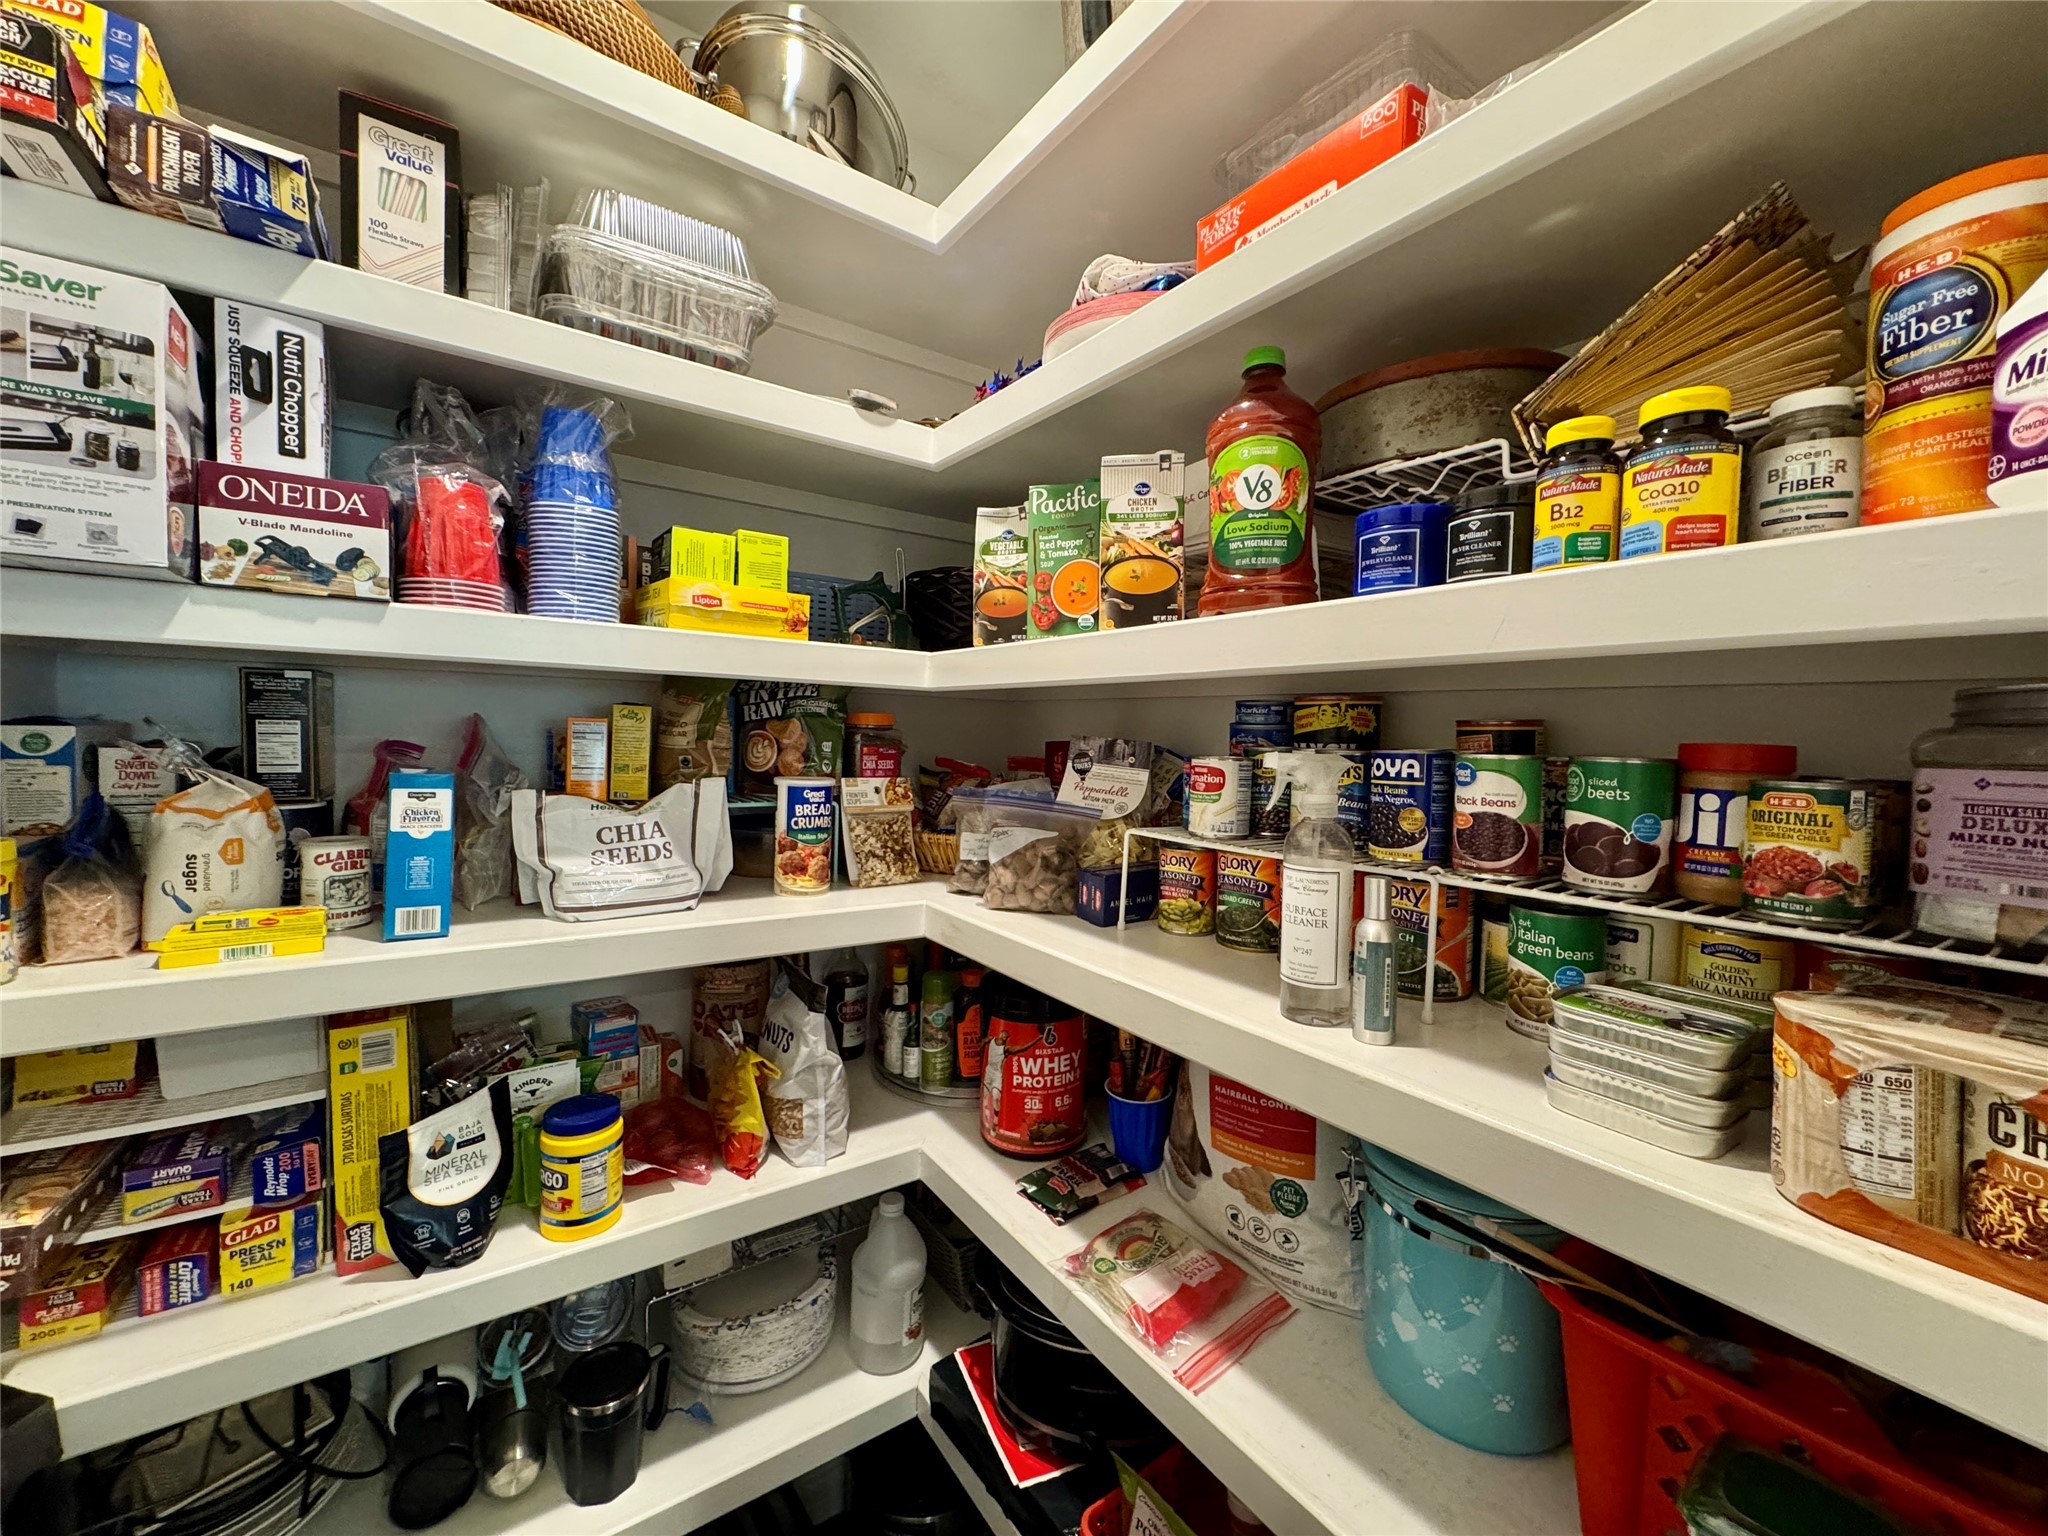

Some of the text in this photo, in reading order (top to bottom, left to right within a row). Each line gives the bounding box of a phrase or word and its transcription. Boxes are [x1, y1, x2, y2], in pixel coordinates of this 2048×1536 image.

[368, 125, 434, 165] Great
[162, 127, 180, 194] PARCHMENT
[384, 148, 434, 175] Value
[183, 150, 201, 186] PAPER
[291, 193, 307, 215] 75
[368, 217, 388, 230] 100
[1200, 201, 1246, 242] PLASTIC
[368, 226, 398, 241] Flexible
[399, 235, 425, 249] Straws
[1203, 218, 1239, 250] FORKS
[1882, 283, 1979, 328] Sugar Free
[1880, 306, 1974, 356] Fiber
[1909, 337, 1963, 360] SUPPLEMENT
[227, 304, 243, 463] JUST SQUEEZE AND CHOP!
[1888, 366, 1965, 394] MADE WITH 100%
[1920, 378, 1961, 394] ORANGE
[20, 382, 104, 404] WAYS TO SAVE
[1666, 445, 1717, 454] RECOMMENDED
[1785, 449, 1832, 463] ocean
[1911, 443, 1948, 458] HEART
[1243, 470, 1273, 503] V8
[1638, 480, 1700, 502] CoQ10
[1778, 476, 1835, 495] FIBER
[218, 474, 369, 517] ONEIDA
[1029, 485, 1100, 515] Pacific
[1127, 497, 1158, 507] CHICKEN
[1659, 497, 1692, 506] STRENGTH
[1900, 496, 1915, 507] 72
[6, 500, 112, 518] PRESERVATION SYSTEM
[1551, 503, 1583, 521] B12
[1667, 505, 1680, 513] mg
[1779, 503, 1828, 514] Daily Prebiotics
[238, 517, 354, 539] V-Blade Mandoline
[1038, 523, 1067, 533] Organic
[1227, 522, 1289, 535] Low Sodium
[1566, 521, 1580, 529] mcg
[1695, 522, 1719, 530] support
[1459, 530, 1489, 541] Brilliant
[990, 541, 1024, 551] VEGETABLE
[1039, 538, 1084, 551] Red Pepper
[1229, 540, 1288, 550] 100% VEGETABLE JUICE
[1371, 544, 1398, 554] Brilliant
[1452, 541, 1502, 554] SILVER CLEANER
[1039, 548, 1079, 559] & Tomato
[1040, 560, 1054, 568] SOUP
[1361, 556, 1383, 567] JEWELRY
[694, 595, 720, 607] Lipton
[743, 700, 785, 721] RAW
[115, 759, 158, 770] Swans
[862, 760, 894, 769] CHIA SEEDS
[1074, 761, 1092, 770] TOURS
[112, 782, 161, 790] Cake Flour
[1074, 781, 1130, 798] Pappardelle
[1588, 778, 1618, 787] sliced
[803, 790, 825, 798] Great
[845, 792, 868, 800] FRONTIER
[1384, 786, 1408, 795] Beans
[1588, 787, 1630, 801] beets
[1339, 797, 1368, 809] Beans
[1385, 795, 1414, 805] Negros
[1457, 795, 1517, 808] Black Beans
[404, 808, 439, 816] Chicken
[795, 805, 831, 817] BREAD
[1967, 804, 2014, 816] LIGHTLY
[402, 815, 441, 823] Flavored
[790, 817, 832, 829] CRUMBS
[1752, 809, 1833, 828] ORIGINAL
[596, 820, 666, 845] CHIA
[1765, 831, 1831, 843] GREEN CHILES
[1776, 825, 1828, 836] TOMATOES
[1948, 832, 2017, 846] MIXED
[314, 849, 372, 866] CLABBE
[591, 842, 673, 866] SEEDS
[1688, 848, 1725, 857] CREAMY
[331, 860, 367, 872] GIRL
[1161, 853, 1198, 872] GLORY
[1220, 855, 1263, 876] GLORY
[182, 854, 198, 893] sugar
[201, 853, 213, 892] granulated
[1137, 895, 1154, 903] HAIR
[1238, 897, 1260, 907] GREENS
[1285, 903, 1328, 918] SURFACE
[1285, 914, 1328, 929] CLEANER
[1518, 917, 1531, 928] cut
[1517, 926, 1556, 945] italian
[1517, 941, 1595, 962] green beans
[1716, 943, 1738, 953] COUNTRY
[1710, 963, 1750, 976] GOLDEN
[1687, 977, 1709, 993] MAIZ
[1703, 969, 1758, 988] HOMINY
[763, 1021, 794, 1054] NUTS
[1020, 1049, 1081, 1075] WHEY
[1884, 1077, 1912, 1090] 650
[1215, 1084, 1258, 1105] HAIRBALL
[340, 1092, 354, 1165] 370 BOLSAS SURTIDAS
[458, 1120, 482, 1133] BAJA
[458, 1127, 483, 1139] GOLD
[308, 1148, 318, 1187] EVERYDAY
[425, 1149, 488, 1178] MINERAL
[152, 1165, 192, 1179] QUART
[264, 1157, 275, 1196] Reynolds
[277, 1152, 290, 1196] Wrap 200
[424, 1157, 488, 1187] SEA SALT
[2003, 1162, 2044, 1190] NO
[152, 1176, 191, 1187] STORAGE
[438, 1176, 479, 1193] FINE GRIND
[1277, 1191, 1300, 1202] PLEDGE
[1284, 1186, 1295, 1194] PET
[224, 1217, 278, 1246] GLAD
[350, 1227, 360, 1260] TEXAS
[361, 1224, 372, 1257] TOUGH
[229, 1238, 286, 1260] PRESS'N
[240, 1252, 276, 1268] SEAL
[169, 1263, 178, 1304] WAX PAPER
[178, 1262, 193, 1304] CUT-RITE
[229, 1278, 253, 1292] 140
[29, 1329, 56, 1341] 200
